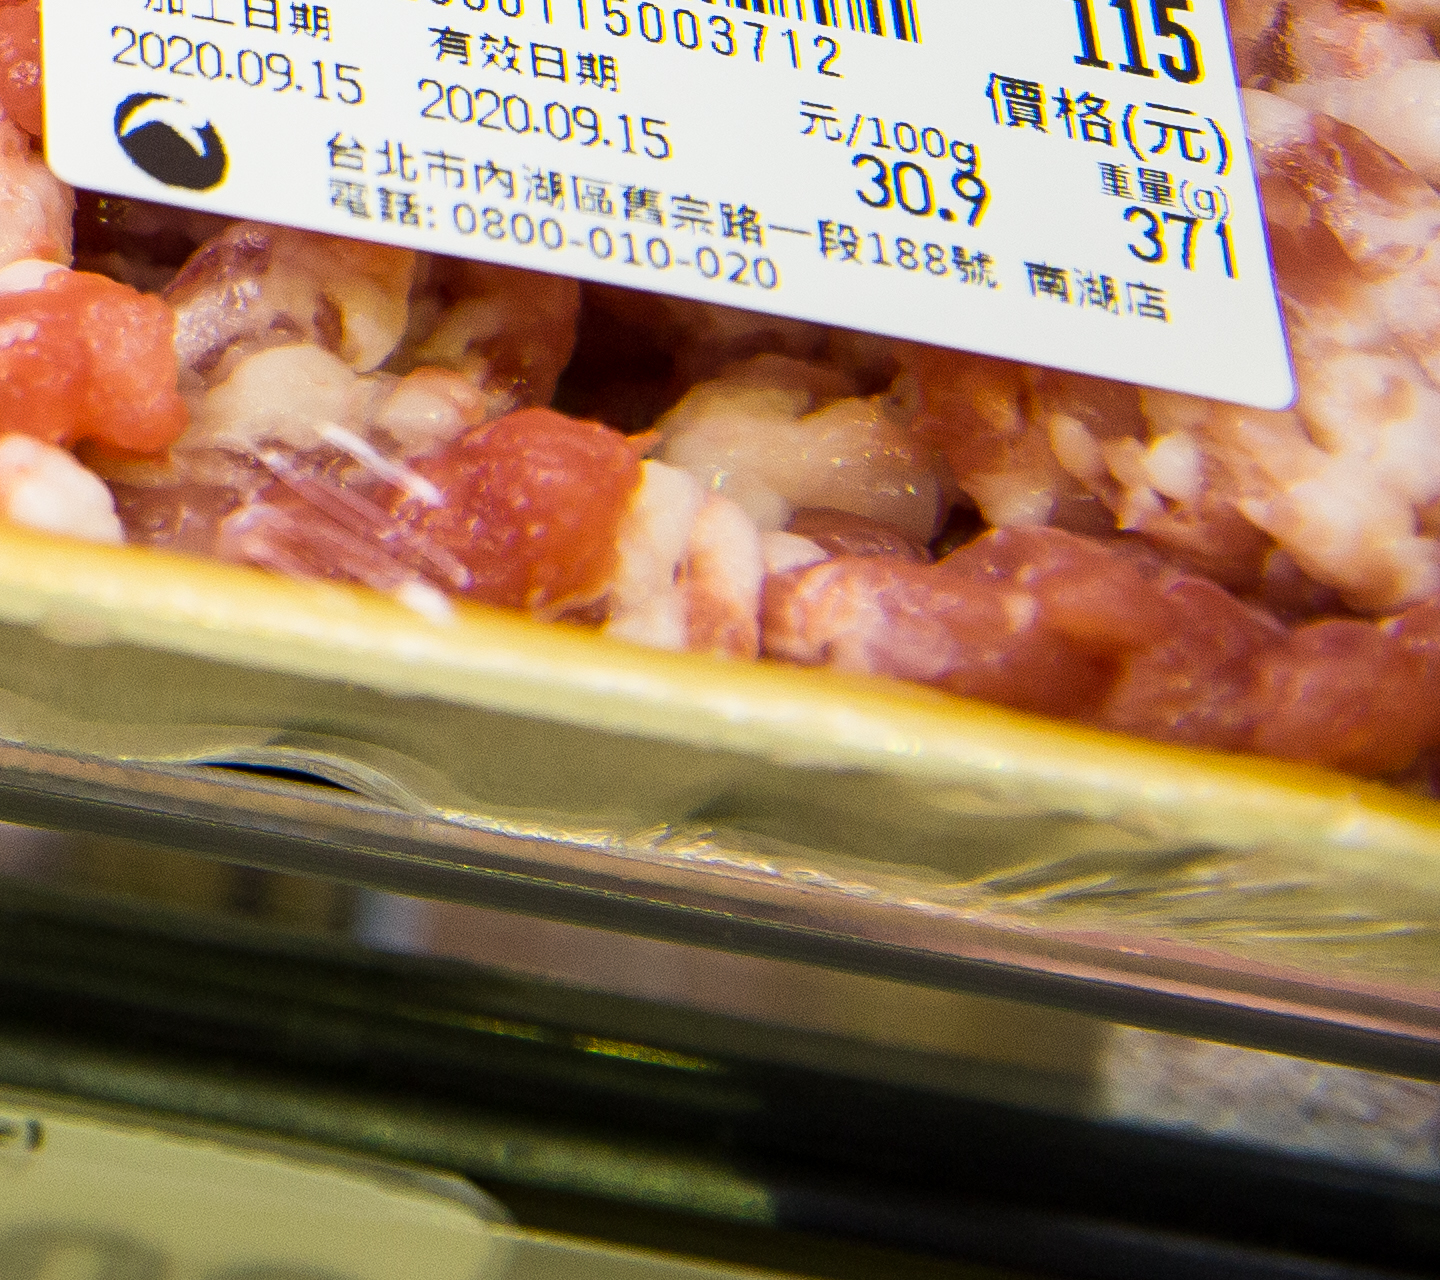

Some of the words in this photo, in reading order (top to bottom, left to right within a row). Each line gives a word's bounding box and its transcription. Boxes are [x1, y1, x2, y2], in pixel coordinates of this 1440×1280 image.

[110, 25, 366, 106] 2020.09.15
[416, 78, 673, 161] 2020.09.15
[427, 26, 621, 93] 有效日期
[798, 100, 981, 178] 元/100g
[985, 72, 1234, 176] 價格(元)
[851, 153, 992, 228] 30.9
[1097, 162, 1232, 221] 重量(g)
[327, 180, 438, 231] 電話:
[452, 201, 781, 292] 0800-010-020
[1122, 206, 1241, 280] 371
[1024, 260, 1170, 323] 南湖店
